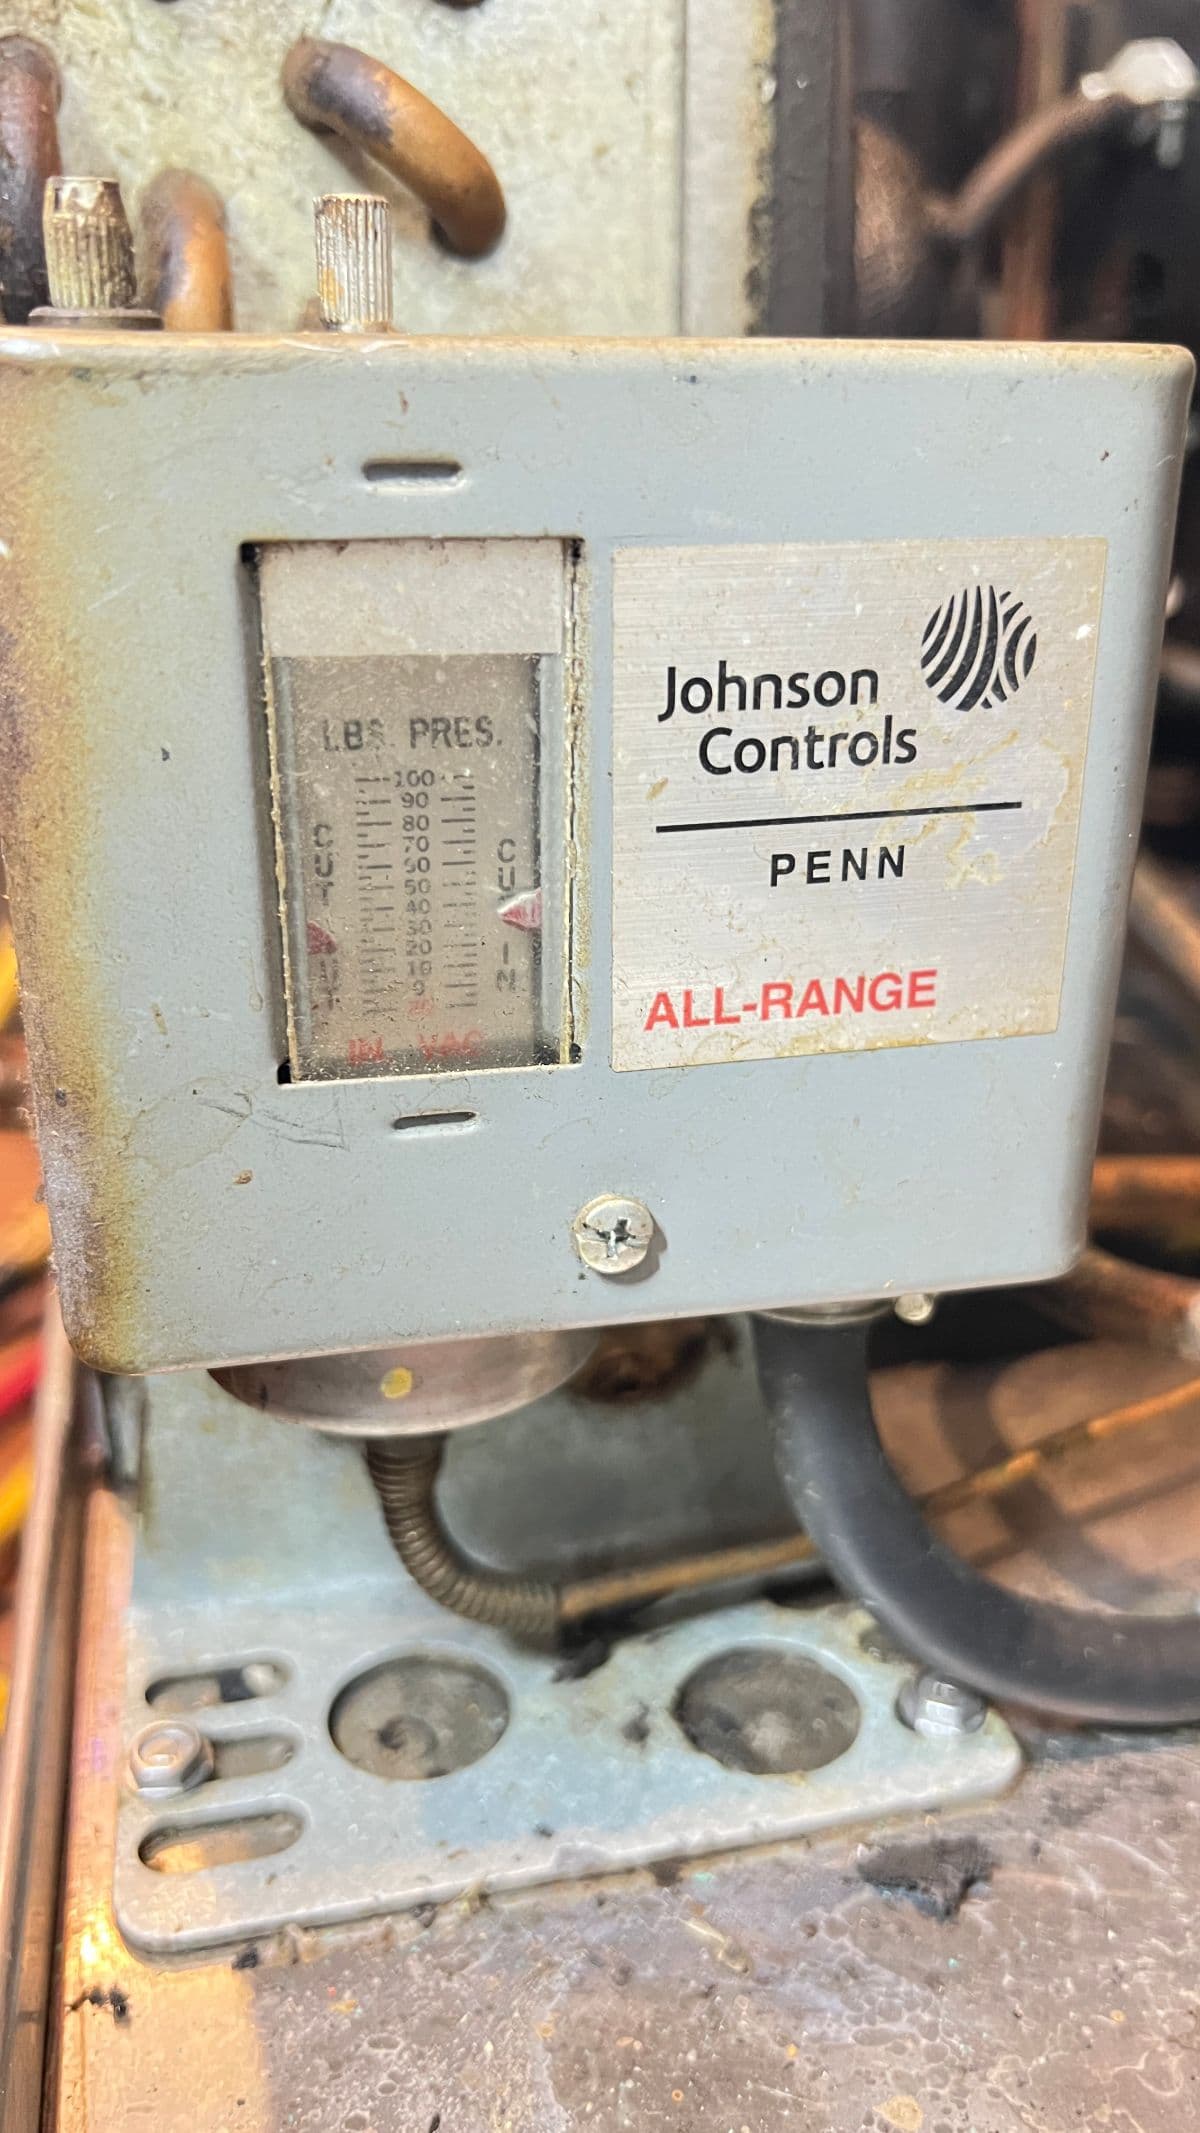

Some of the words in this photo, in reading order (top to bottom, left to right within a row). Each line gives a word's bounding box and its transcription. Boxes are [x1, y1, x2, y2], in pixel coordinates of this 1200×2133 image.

[658, 660, 879, 722] Johnson
[409, 715, 502, 748] PRES.
[699, 716, 917, 775] Controls
[395, 769, 435, 788] 100
[401, 791, 430, 809] 90
[402, 815, 430, 832] 80
[403, 835, 430, 852] 70
[497, 838, 516, 902] CU
[770, 845, 906, 887] PENN
[404, 878, 432, 895] 50
[406, 898, 431, 914] 40
[406, 919, 432, 935] 30
[406, 939, 432, 956] 20
[408, 959, 432, 976] 10
[644, 969, 937, 1032] ALL-RANGE
